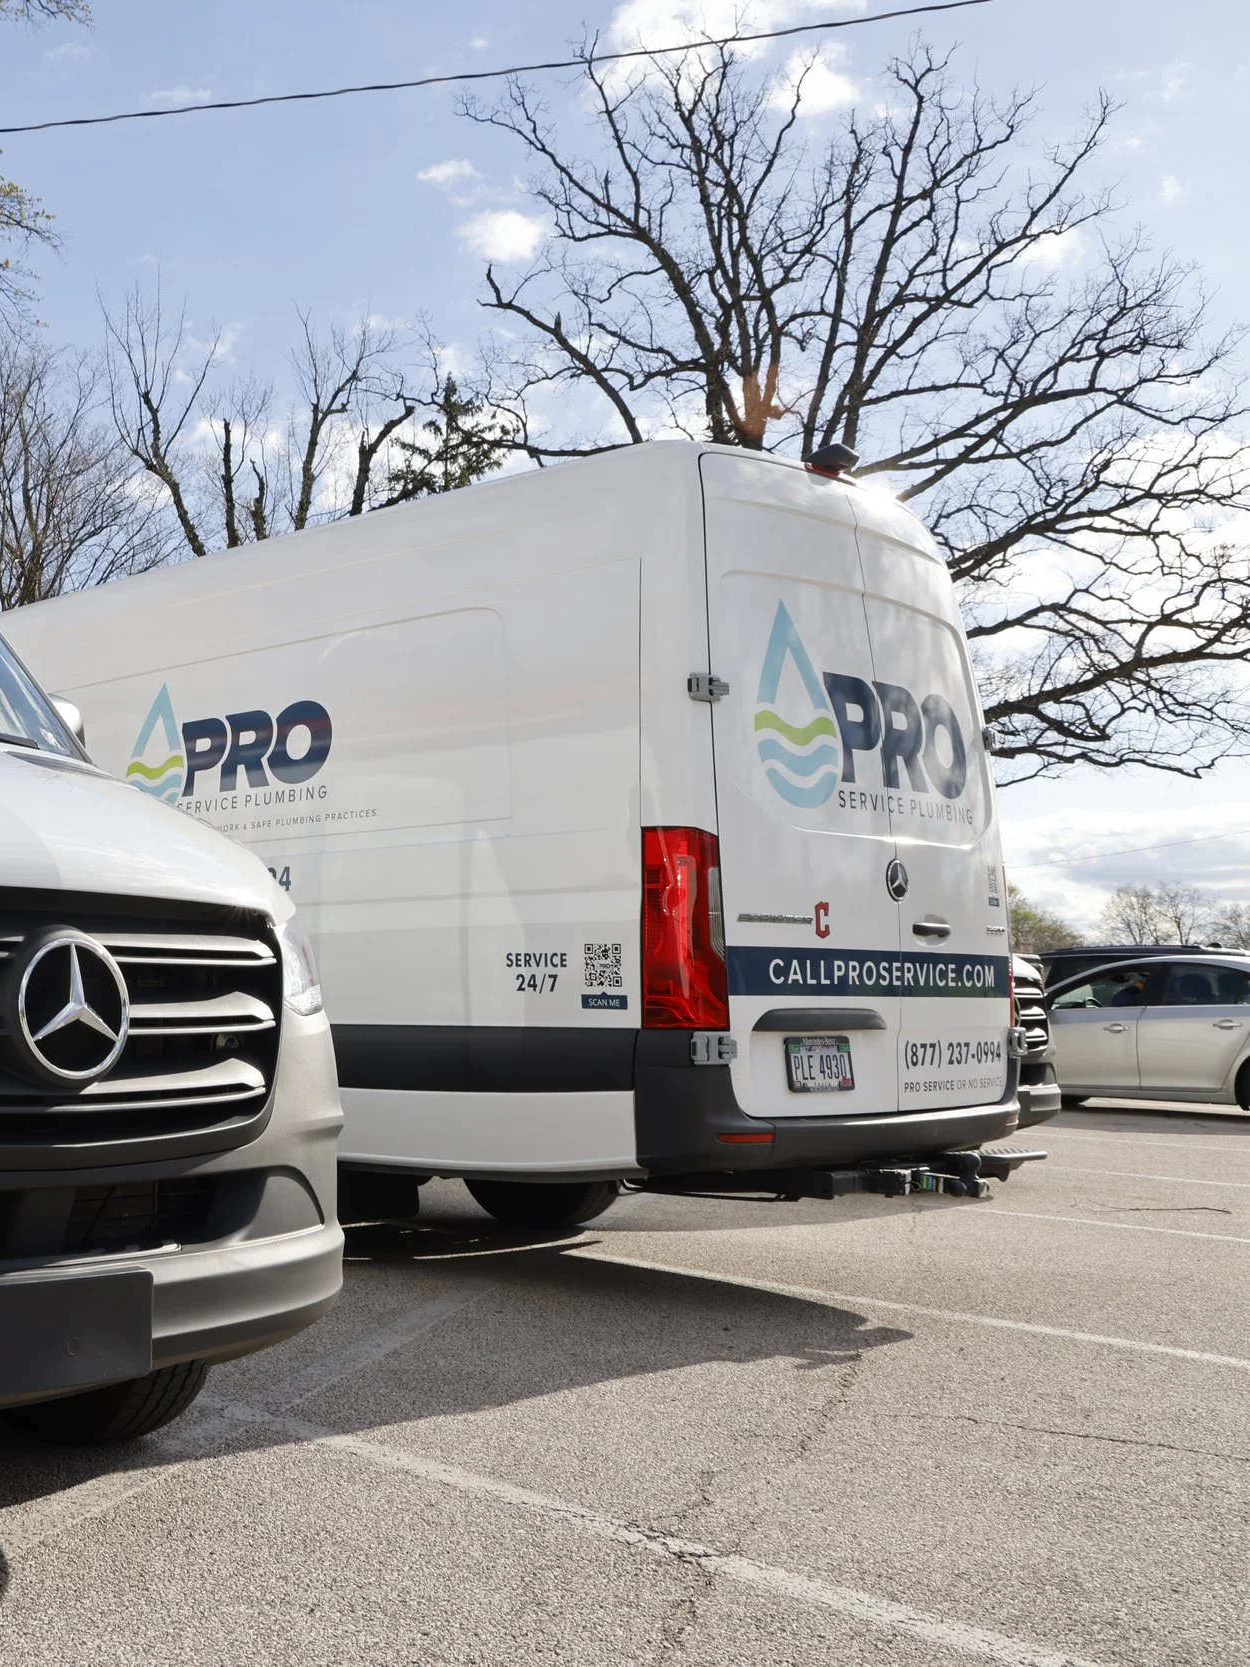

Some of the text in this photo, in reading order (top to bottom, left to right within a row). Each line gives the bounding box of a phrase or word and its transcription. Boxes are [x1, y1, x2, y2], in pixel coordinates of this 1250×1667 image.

[823, 671, 967, 800] PRO
[181, 700, 332, 797] PRO
[245, 785, 328, 808] PLUMBING
[838, 790, 973, 825] SERVICE PLUMBING
[251, 820, 272, 830] SAFE
[275, 815, 321, 827] PLUMBING
[325, 809, 380, 822] PRACTICES.
[506, 953, 567, 967] SERVICE
[516, 974, 558, 994] 24/7
[769, 958, 995, 987] CALLPROSERVICE.COM
[609, 999, 620, 1007] ME
[905, 1040, 1001, 1069] (877) 237-0994
[793, 1054, 847, 1080] PLE 4930
[904, 1081, 921, 1093] PRO
[923, 1080, 955, 1092] SERVICE
[956, 1079, 966, 1090] OR
[968, 1078, 978, 1089] NO
